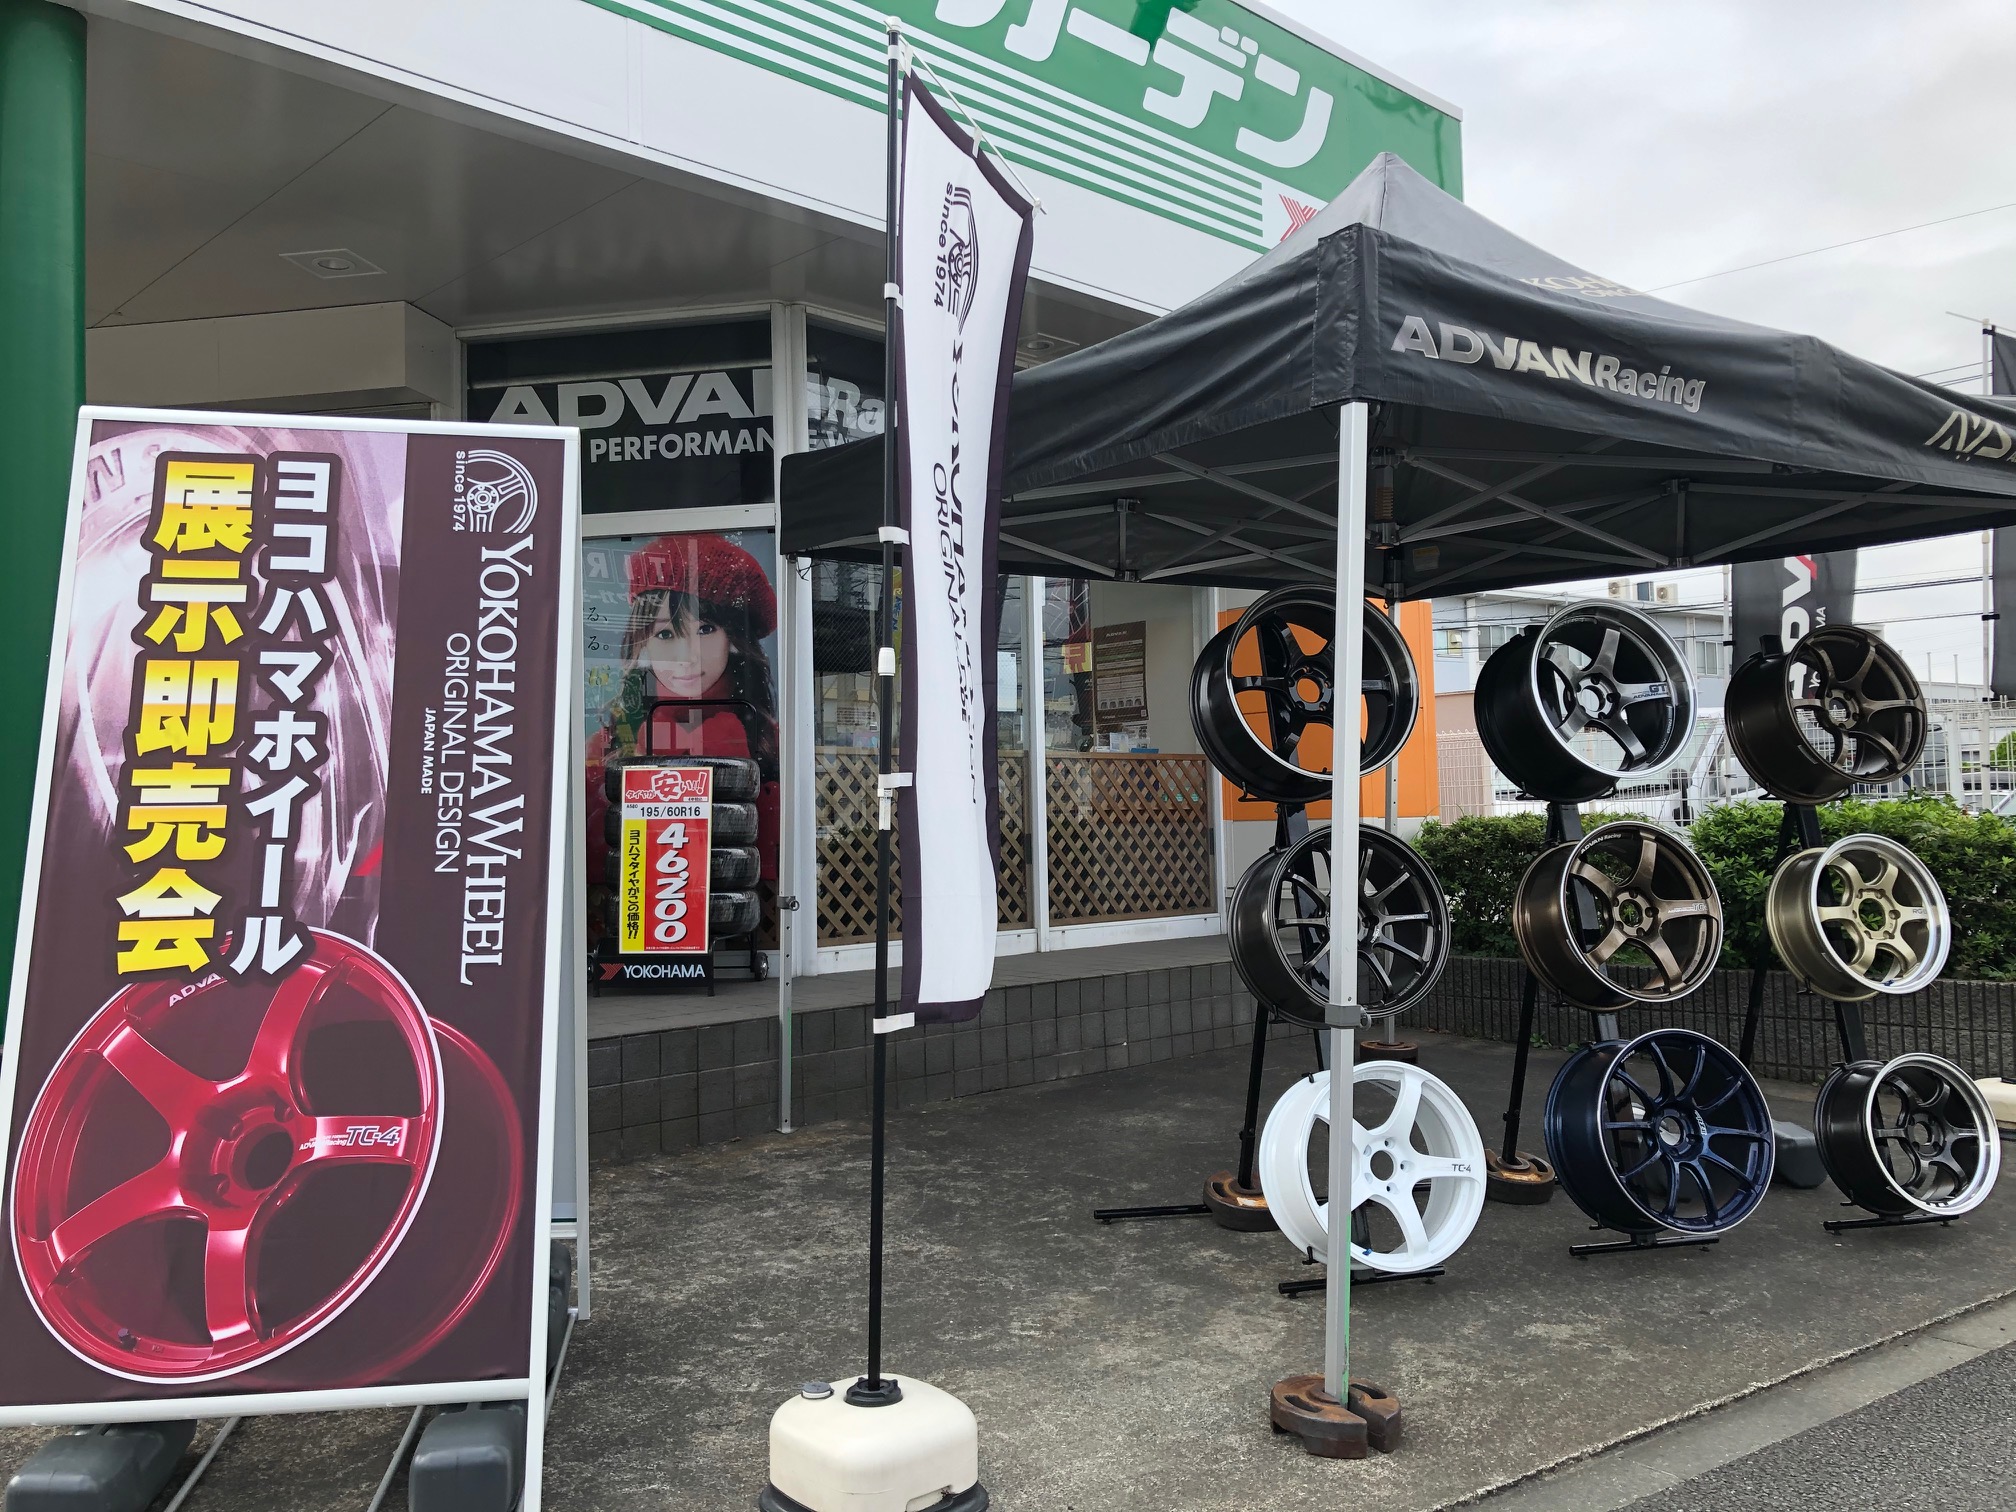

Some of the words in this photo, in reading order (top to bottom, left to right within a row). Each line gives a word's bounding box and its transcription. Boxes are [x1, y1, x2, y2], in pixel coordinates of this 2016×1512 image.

[938, 181, 954, 248] since
[933, 254, 947, 307] 1974
[589, 427, 776, 463] PERFORMAN
[454, 450, 468, 493] since
[452, 495, 466, 532] 1974
[116, 460, 256, 974] 展示即売会
[230, 461, 331, 975] ヨコハマホイール
[441, 631, 470, 764] ORIGINAL
[423, 707, 436, 747] JAPAN
[420, 749, 433, 795] MADE
[434, 771, 464, 873] DESIGN
[640, 806, 701, 818] 195/60R16
[1580, 836, 1603, 854] ADVAN
[654, 822, 690, 943] 46,200
[169, 972, 222, 1008] ADVA
[623, 964, 706, 978] YOKOHAMA
[346, 1125, 402, 1147] TC-4
[1451, 1163, 1472, 1173] TC-4
